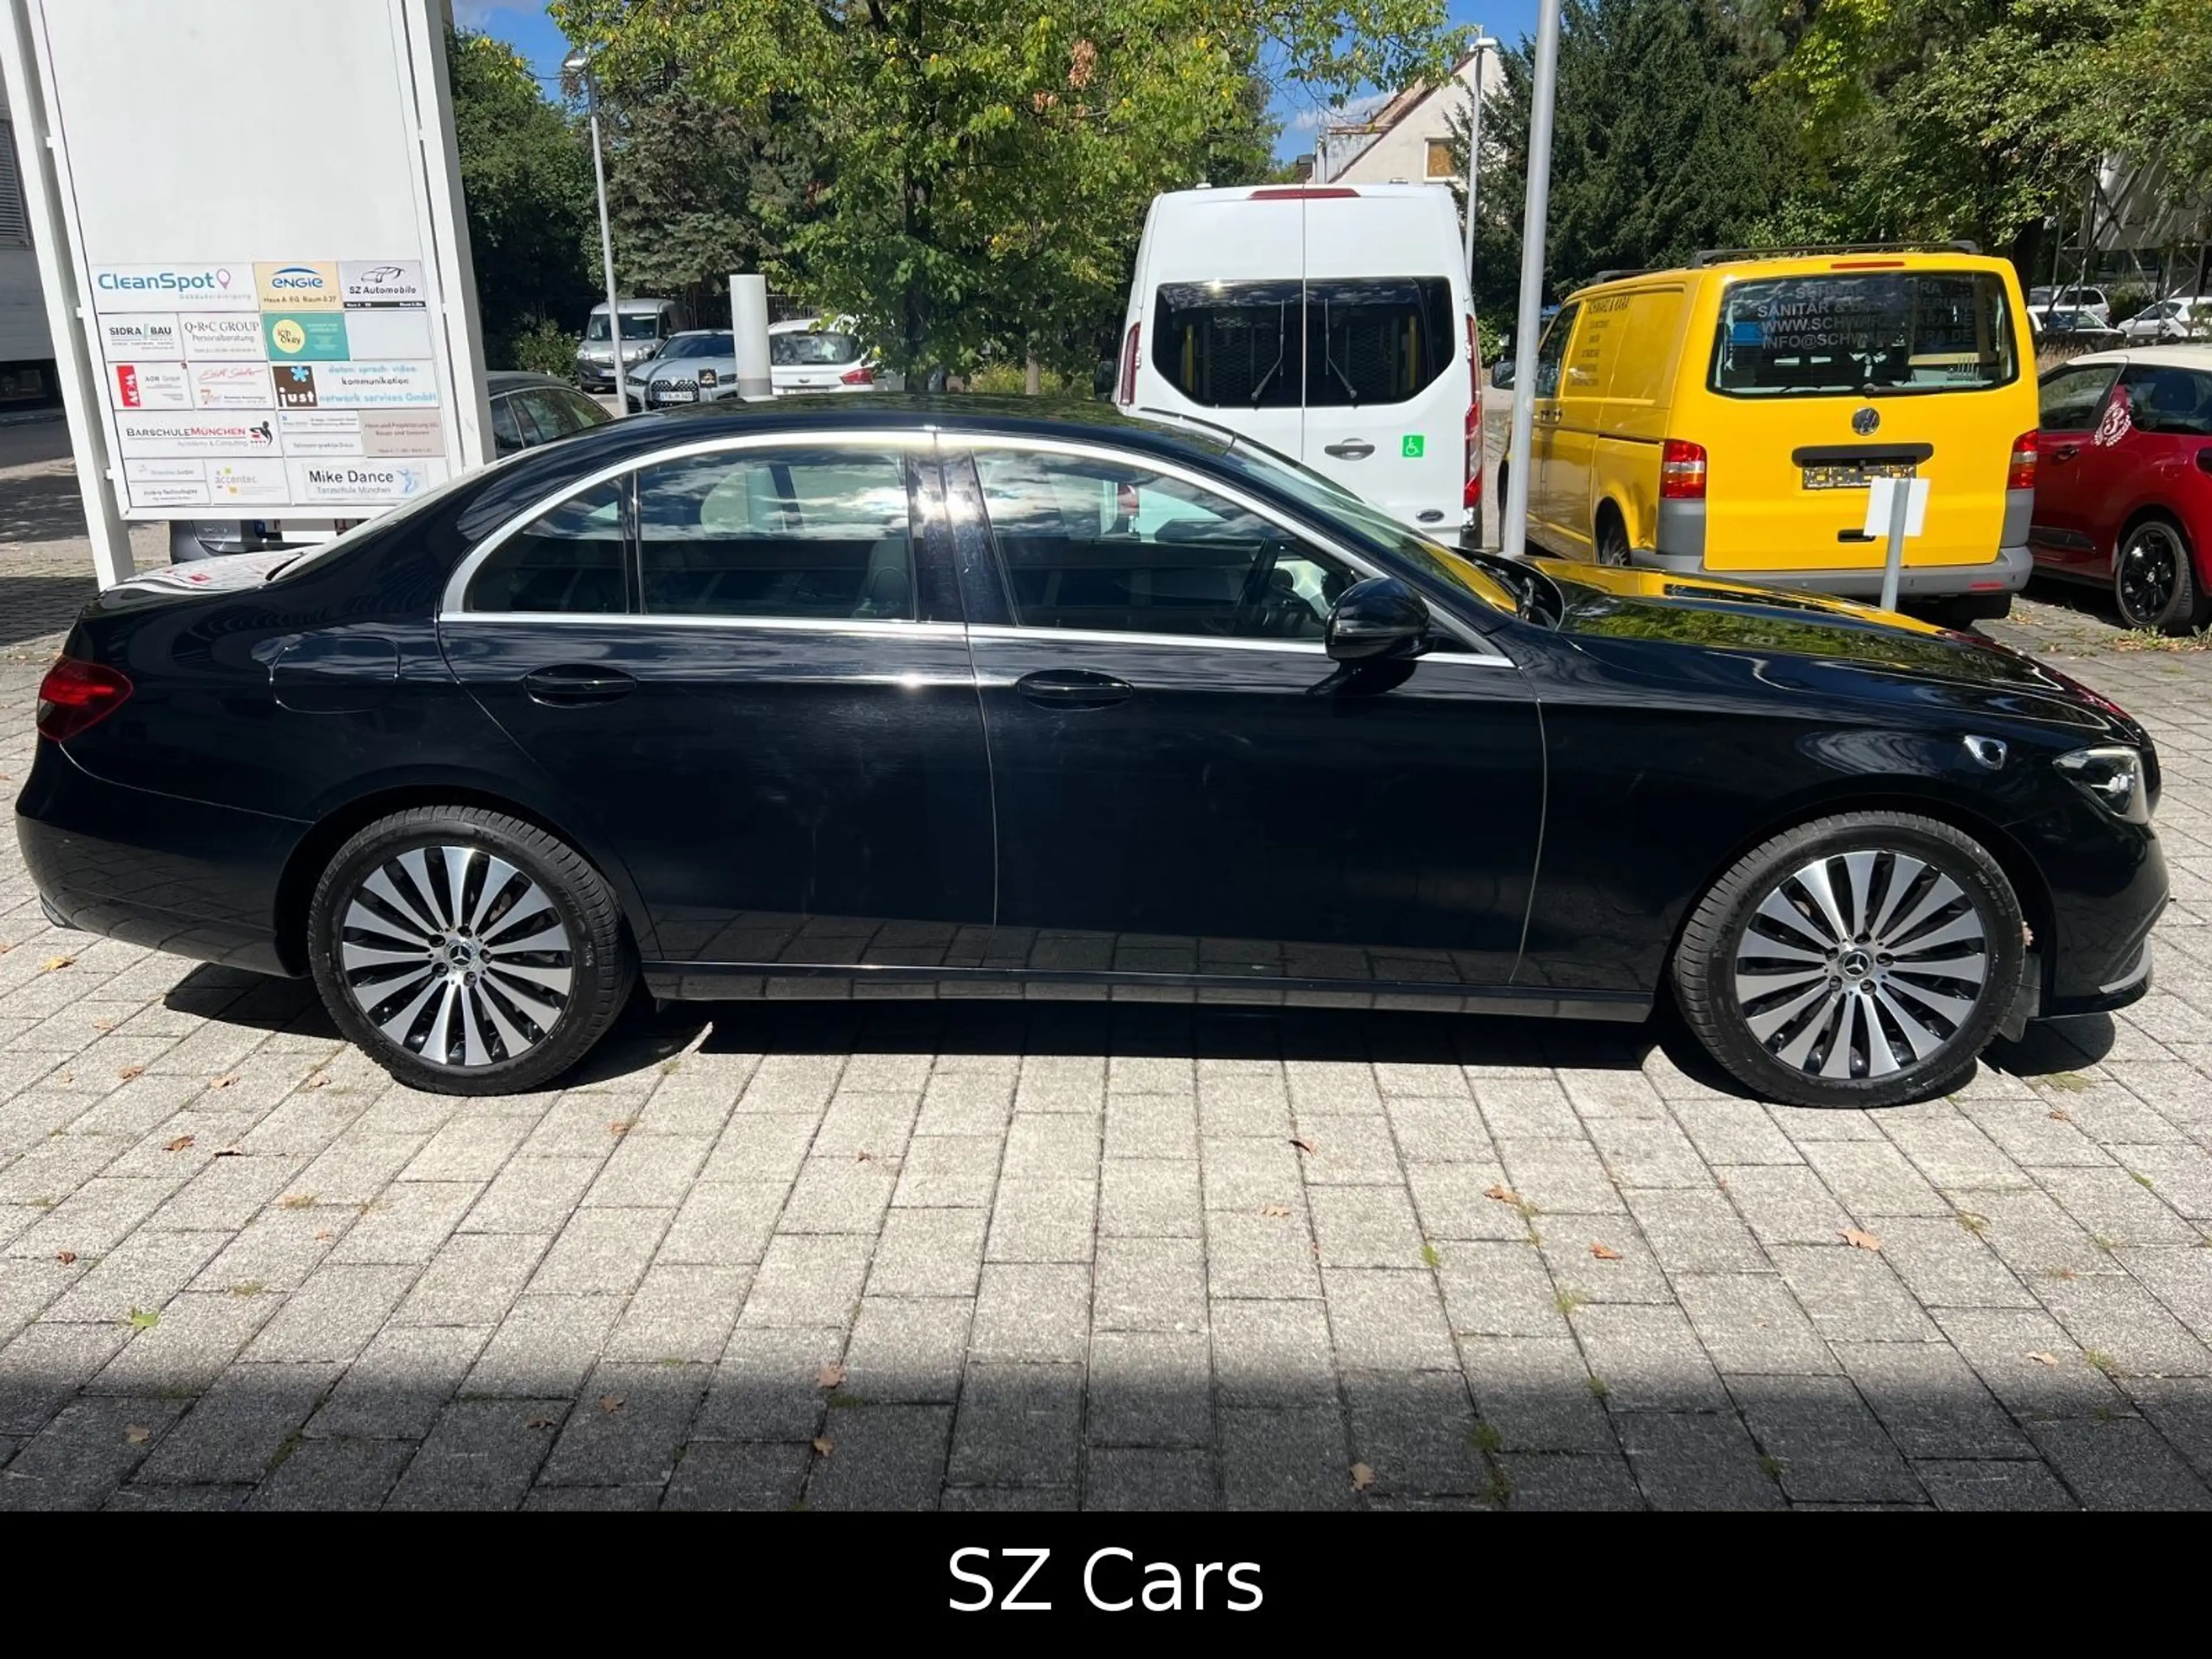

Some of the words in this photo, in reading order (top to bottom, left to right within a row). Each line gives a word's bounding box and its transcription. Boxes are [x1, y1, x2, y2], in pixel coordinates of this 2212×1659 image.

[98, 272, 215, 292] CleanSpot
[362, 286, 416, 294] Automobile
[150, 327, 172, 335] BAU
[219, 321, 259, 331] GROUP
[342, 377, 409, 385] kommunikation
[278, 387, 314, 407] just
[319, 392, 360, 402] network
[309, 471, 343, 483] Mike
[348, 469, 394, 483] Dance
